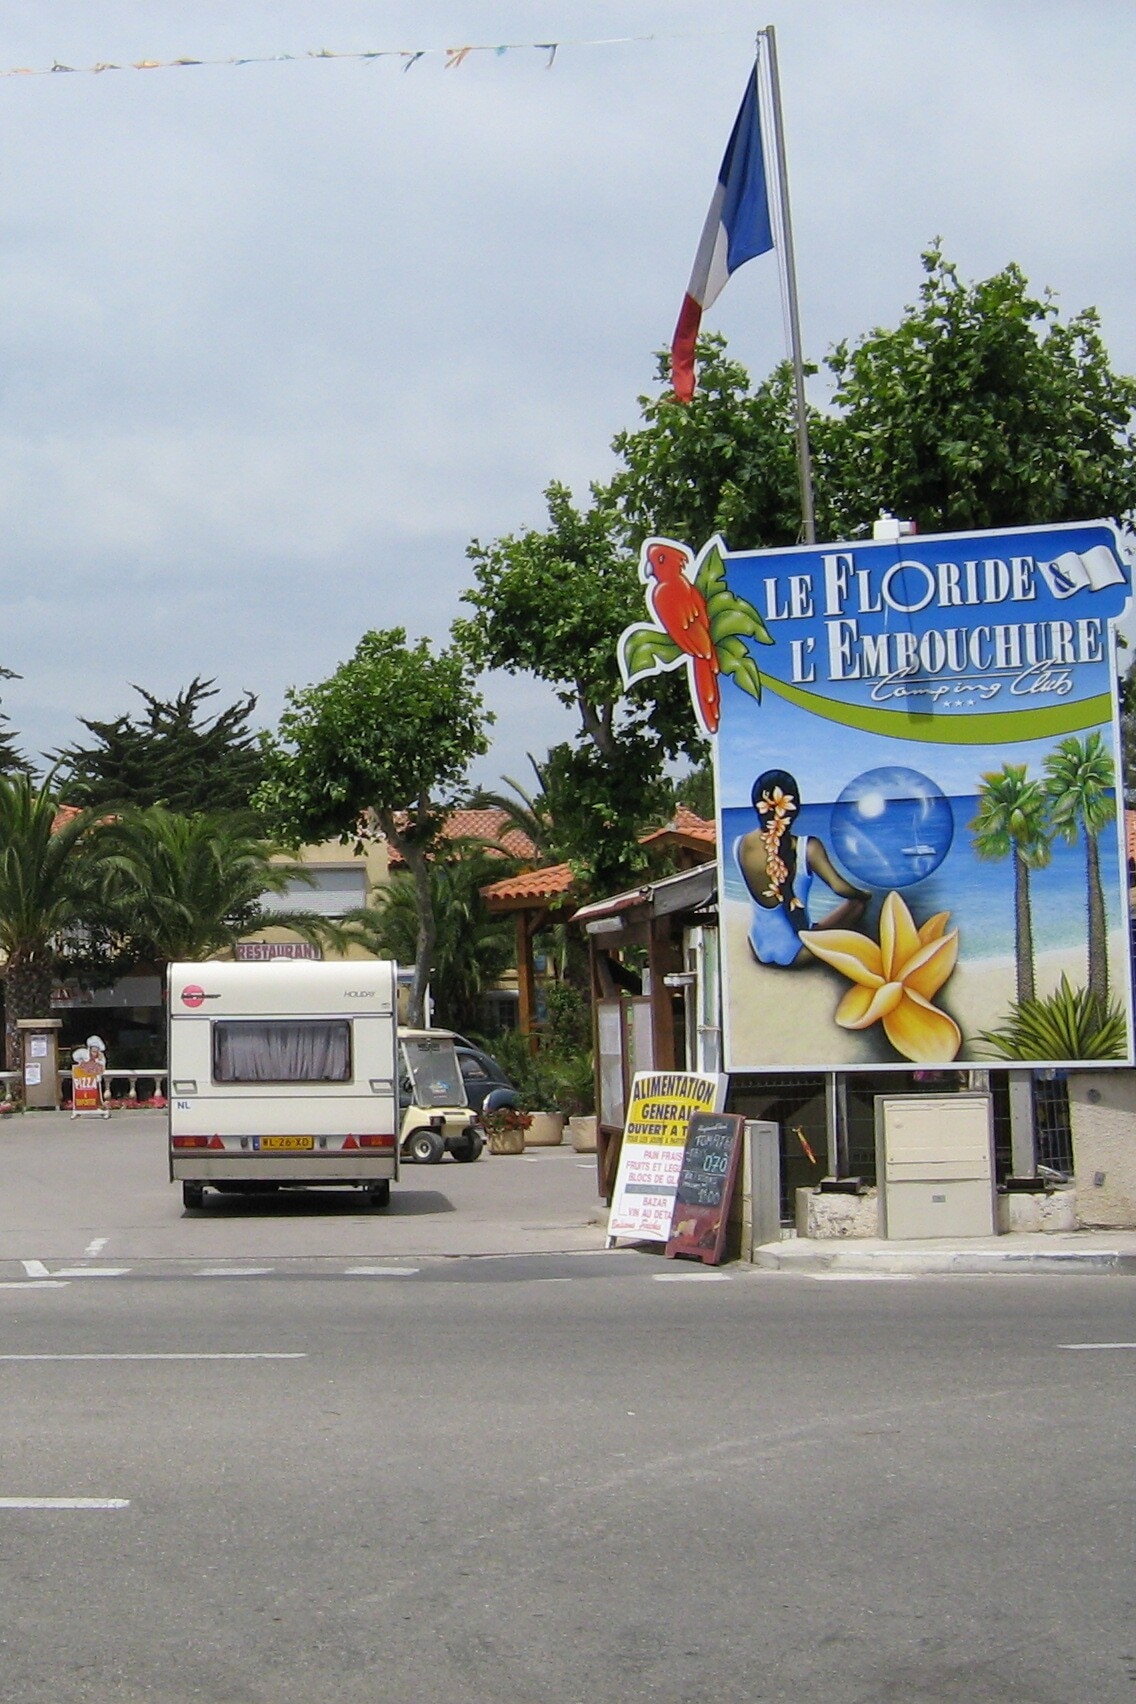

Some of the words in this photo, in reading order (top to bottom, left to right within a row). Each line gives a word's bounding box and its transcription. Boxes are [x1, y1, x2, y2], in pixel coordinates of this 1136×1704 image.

[764, 575, 813, 621] LE
[821, 553, 1037, 616] FLORIDE
[1048, 563, 1073, 592] &
[827, 618, 1104, 683] EMBOUCHURE
[870, 666, 1002, 702] Camping
[1010, 659, 1073, 696] Club
[75, 1078, 97, 1090] PIZZA
[633, 1075, 715, 1105] ALIMENTATION
[177, 1101, 191, 1109] NL
[628, 1123, 667, 1135] OUVERT
[671, 1125, 678, 1136] A
[626, 1161, 650, 1171] FRUITS
[652, 1163, 662, 1171] ET
[628, 1172, 652, 1182] BLOCS
[654, 1175, 664, 1183] DE
[642, 1197, 667, 1207] BAZAR
[628, 1208, 640, 1217] VIN
[642, 1209, 652, 1218] AU
